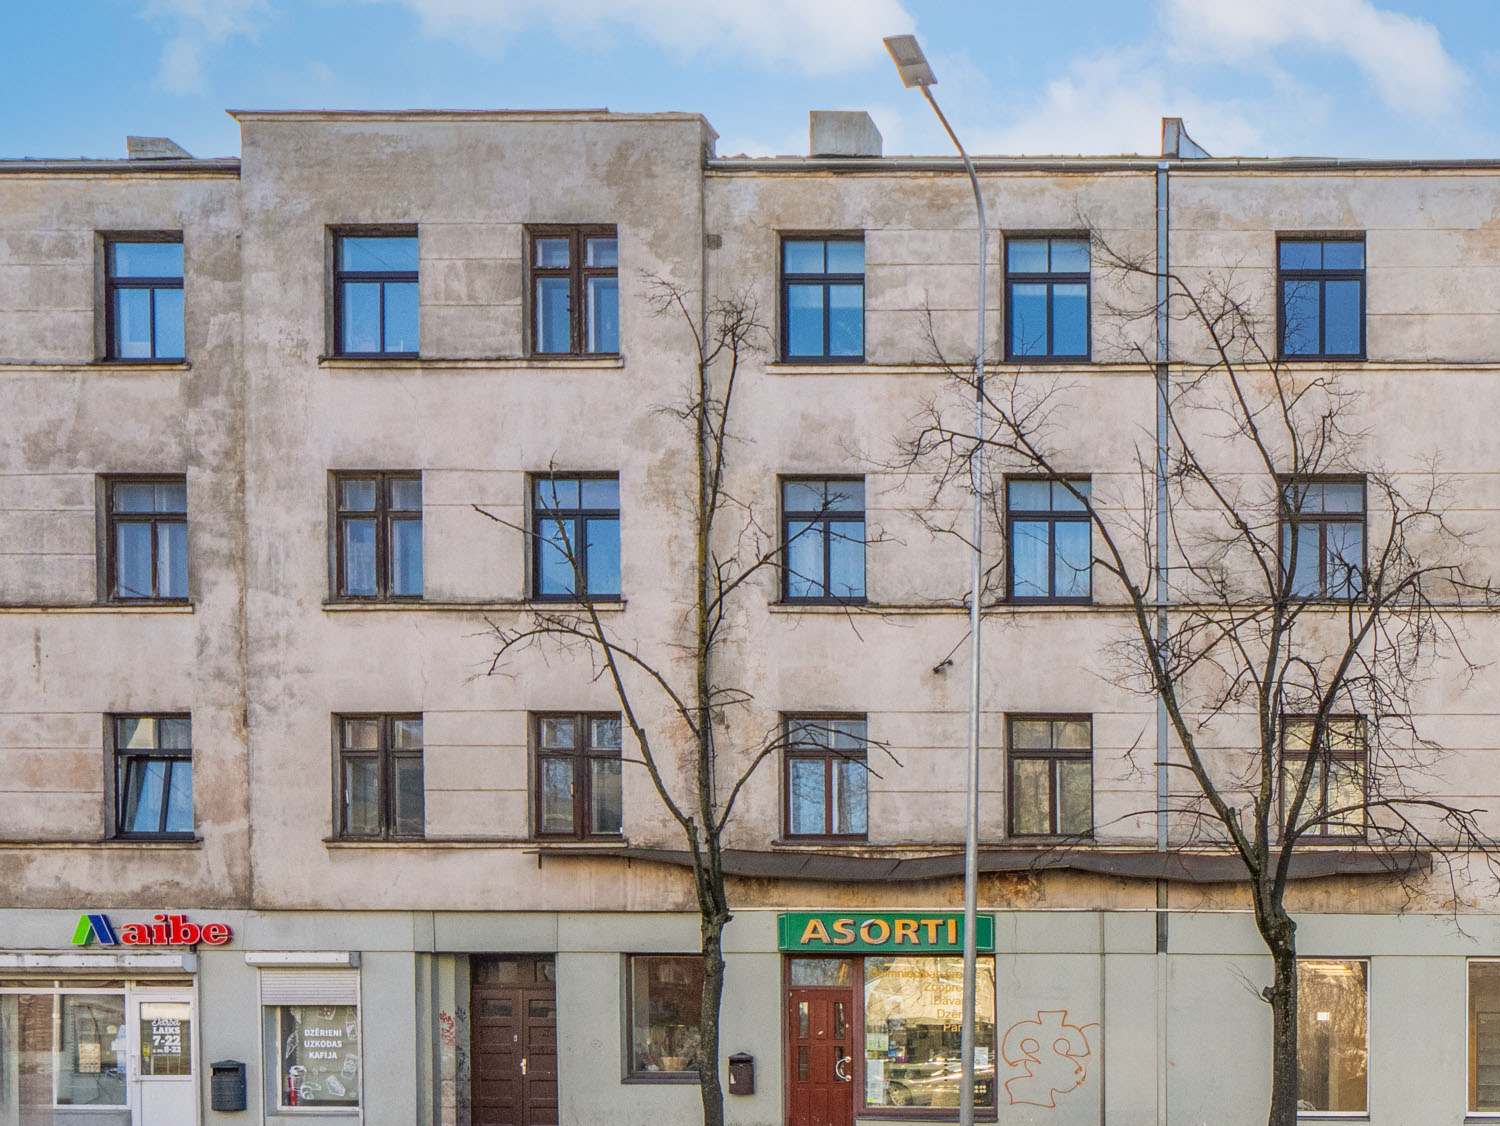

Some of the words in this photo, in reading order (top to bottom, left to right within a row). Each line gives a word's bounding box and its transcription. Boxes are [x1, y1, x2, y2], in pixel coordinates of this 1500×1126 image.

[121, 914, 233, 945] aibe
[800, 918, 958, 945] ASORTI
[924, 982, 981, 993] Zoopres
[304, 1028, 342, 1037] DZĒRIENI
[153, 1035, 181, 1046] 7-22
[304, 1040, 342, 1048] UZKODAS
[309, 1052, 338, 1060] KAFIJA
